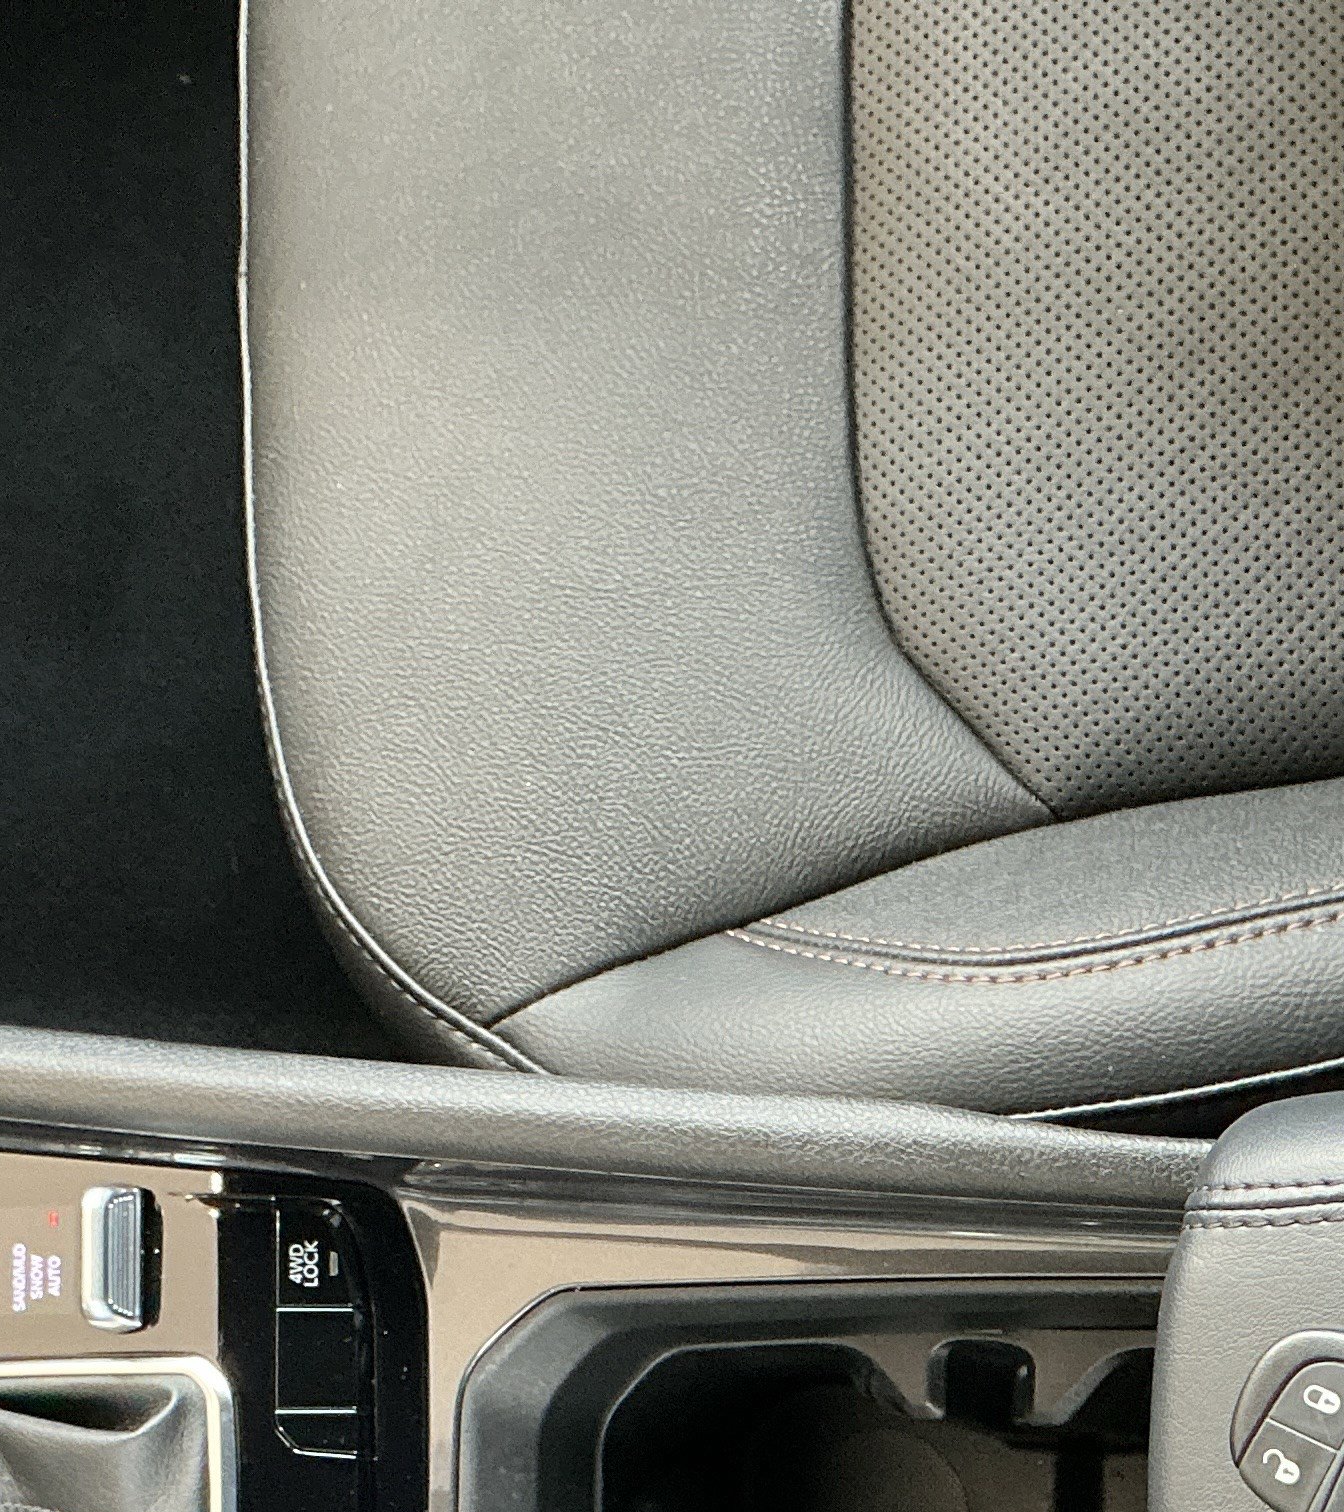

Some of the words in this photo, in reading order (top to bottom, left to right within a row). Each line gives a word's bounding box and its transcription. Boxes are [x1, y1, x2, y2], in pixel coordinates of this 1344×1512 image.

[12, 1243, 27, 1312] SAND/MUD
[29, 1254, 44, 1300] SNOW
[47, 1255, 62, 1296] AUTO
[288, 1244, 304, 1284] 4WD
[303, 1240, 319, 1287] LOCK
